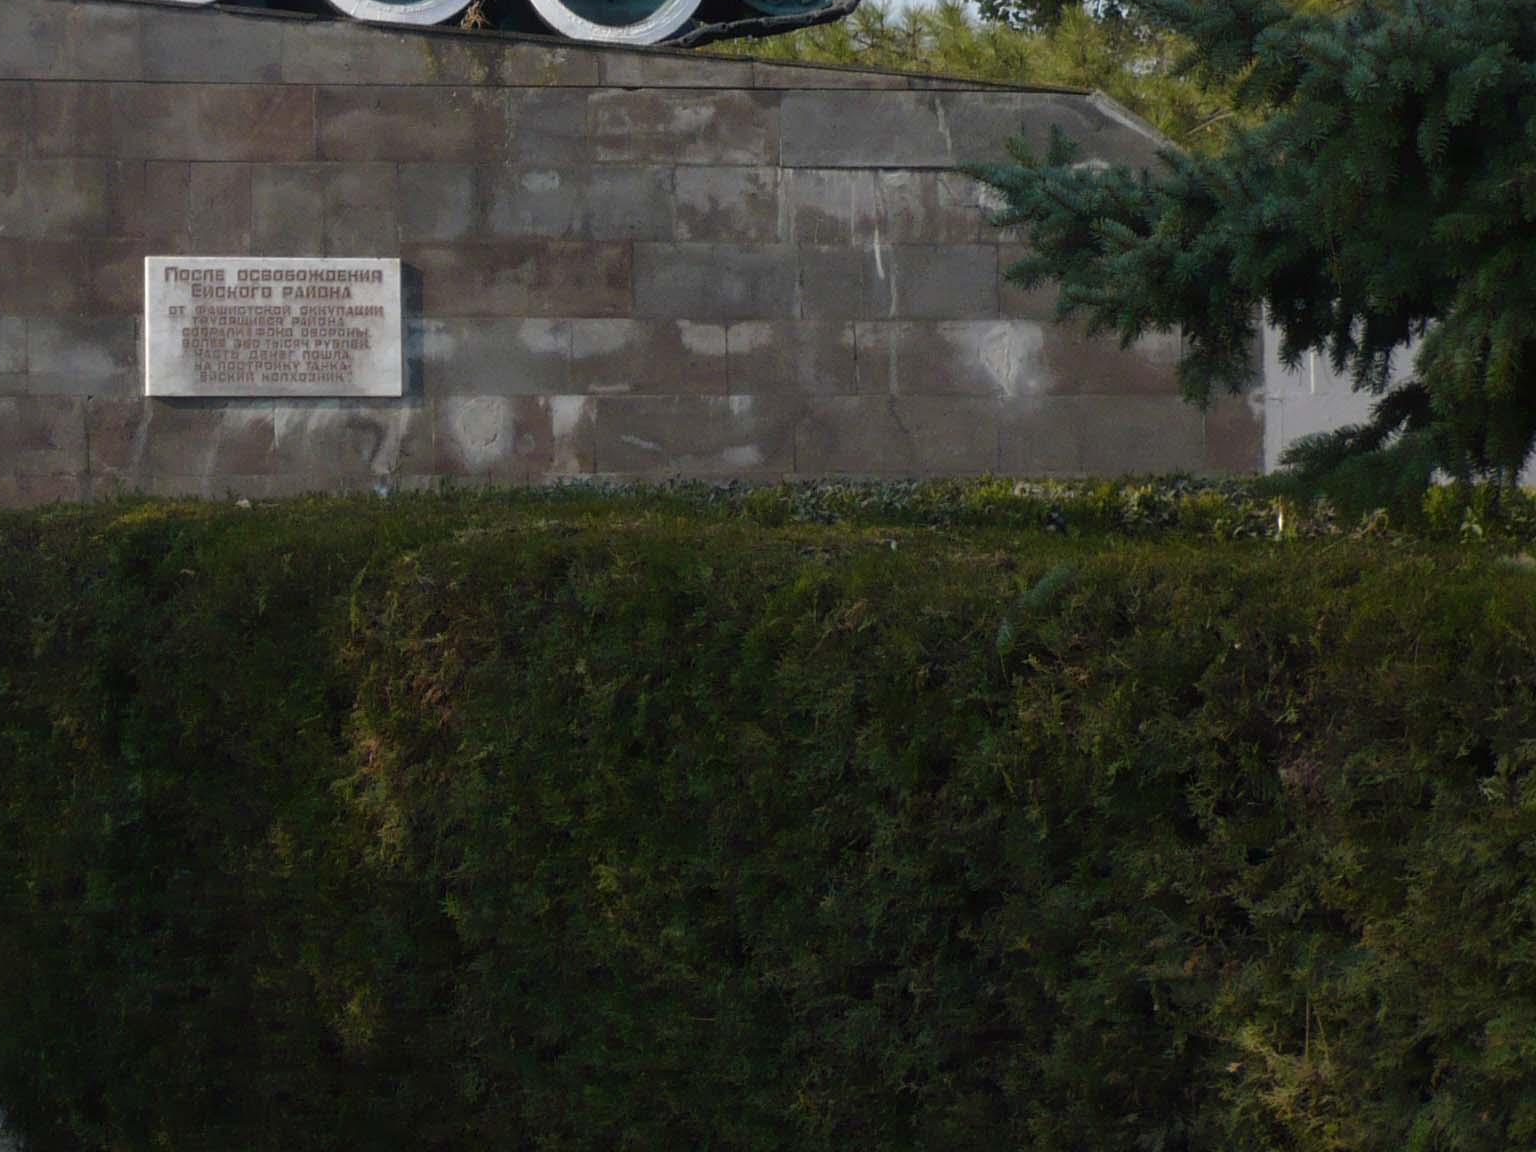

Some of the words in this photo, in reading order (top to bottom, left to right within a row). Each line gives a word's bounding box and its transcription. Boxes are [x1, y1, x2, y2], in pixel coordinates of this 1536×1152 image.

[164, 266, 225, 283] ПОСЛЕ
[237, 268, 383, 284] ОСВОБОЖДЕНИЯ
[191, 282, 273, 299] ЕЙСКОГО
[282, 285, 352, 299] РАЙОНА
[168, 305, 185, 316] ОТ
